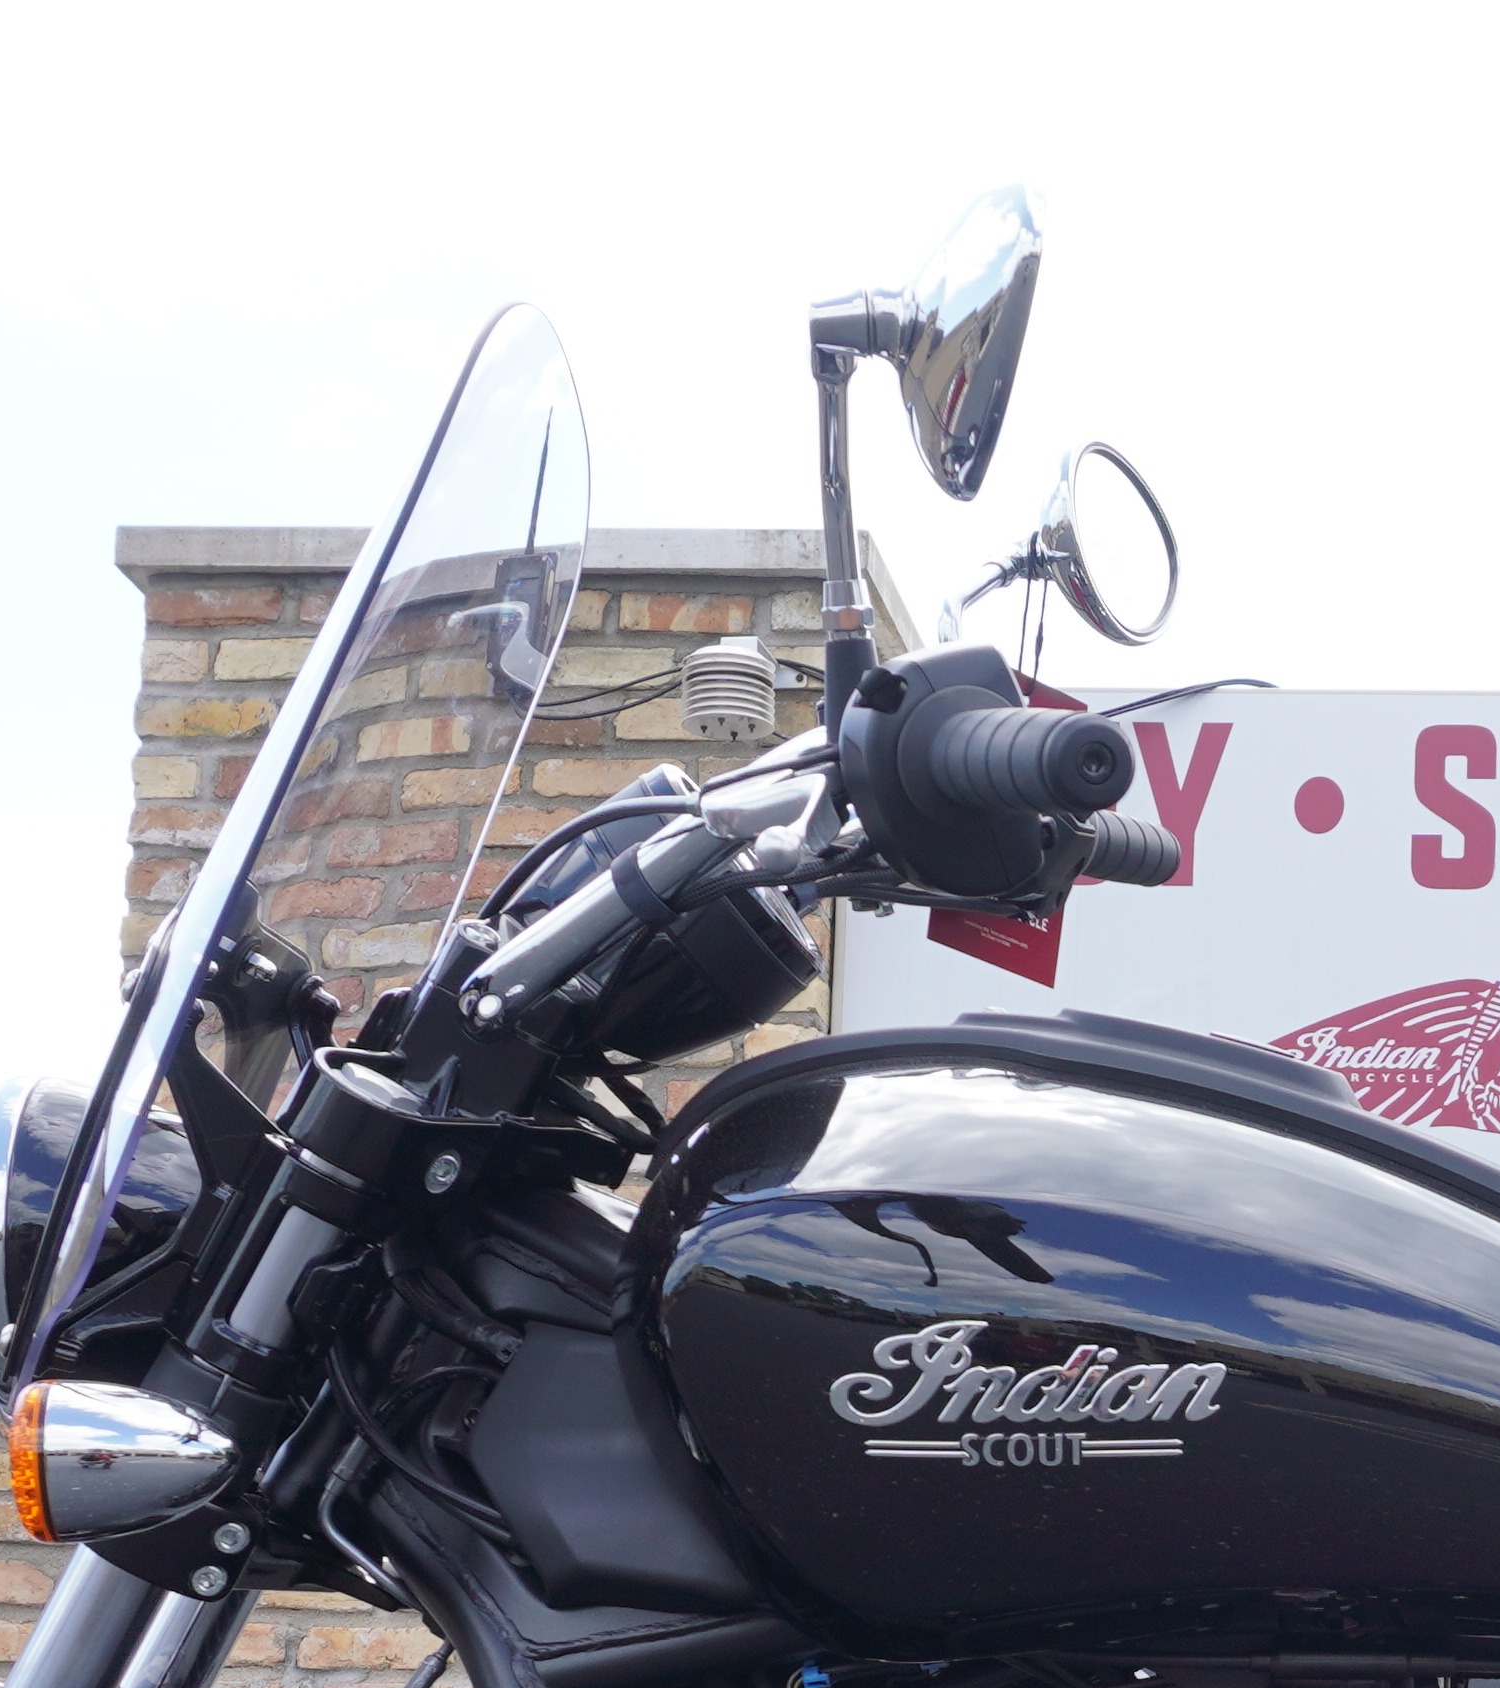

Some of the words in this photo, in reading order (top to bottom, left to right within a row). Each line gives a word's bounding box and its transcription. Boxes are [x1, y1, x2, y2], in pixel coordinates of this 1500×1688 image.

[1284, 1027, 1442, 1071] Indian
[1350, 1072, 1435, 1084] RCYCLE
[829, 1319, 1228, 1428] Indian
[961, 1431, 1088, 1468] SCOUT
